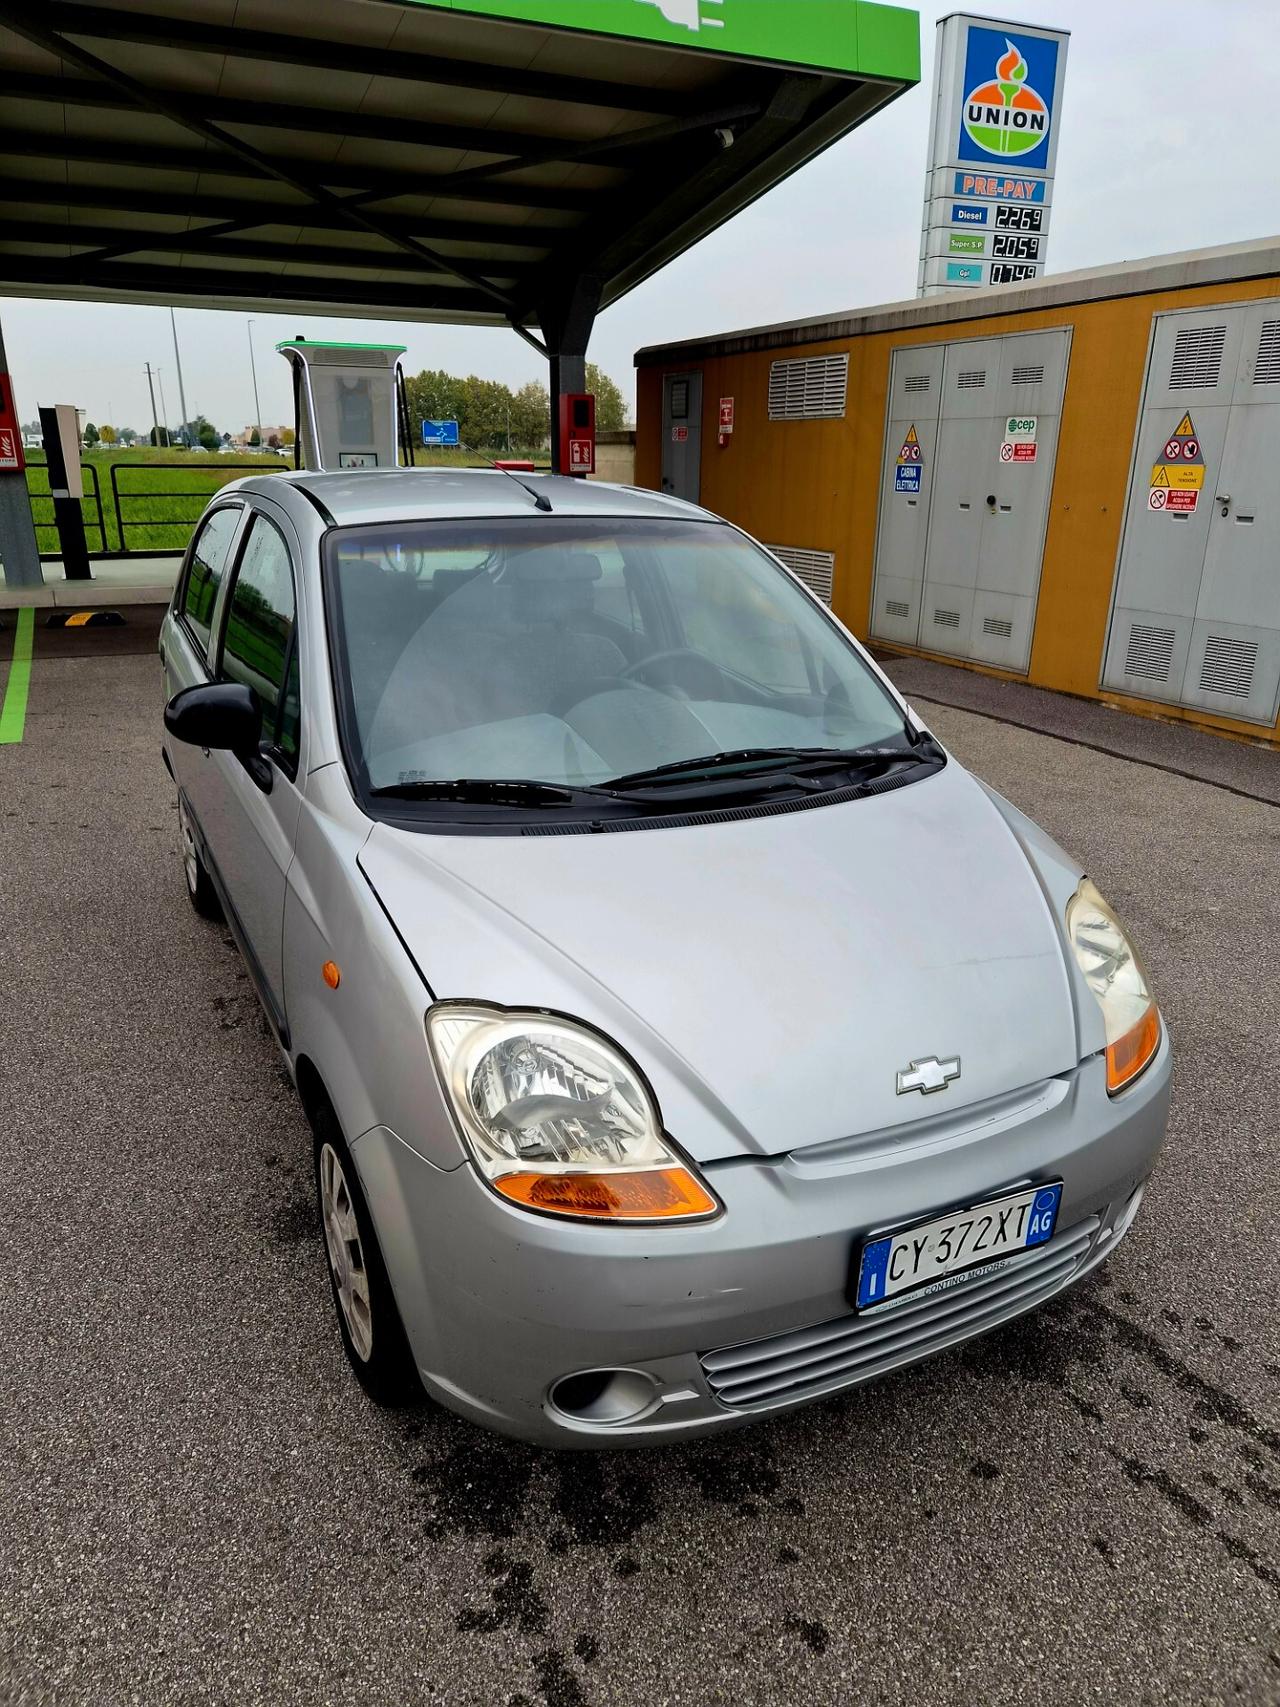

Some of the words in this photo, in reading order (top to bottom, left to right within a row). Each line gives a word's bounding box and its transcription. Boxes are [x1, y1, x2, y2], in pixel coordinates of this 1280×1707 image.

[968, 105, 1045, 130] UNION
[962, 175, 1037, 199] PRE-PAY
[958, 210, 982, 220] Diesel
[951, 239, 970, 248] Super
[1017, 420, 1035, 432] cep
[901, 467, 916, 478] CABINA
[1030, 1211, 1052, 1235] AG
[923, 1274, 966, 1296] CONTINO
